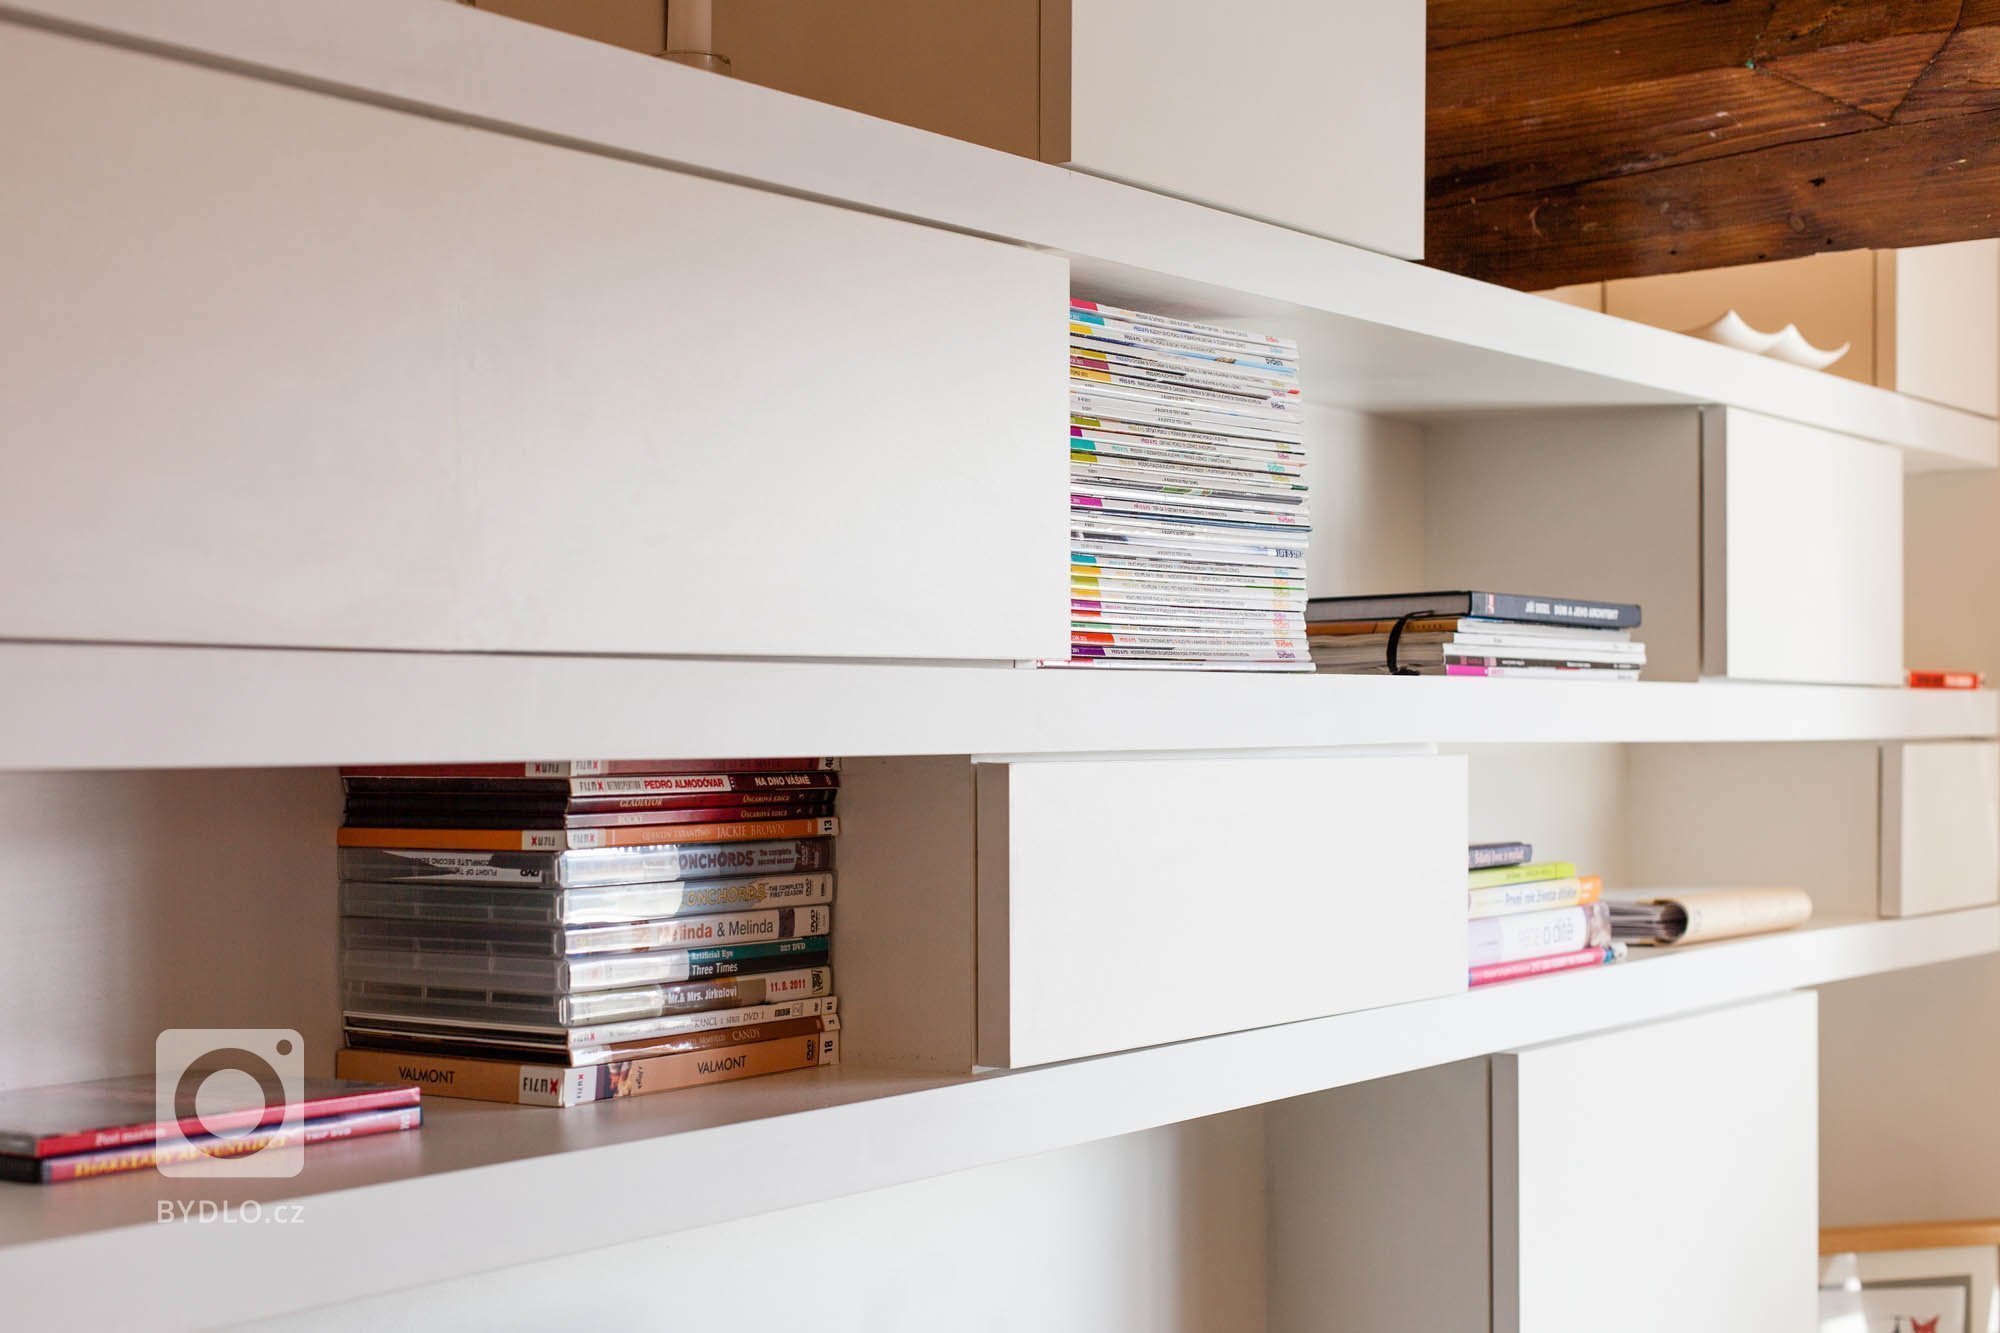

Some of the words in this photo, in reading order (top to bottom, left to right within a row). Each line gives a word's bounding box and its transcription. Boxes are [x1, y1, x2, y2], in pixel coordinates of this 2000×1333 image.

[644, 780, 672, 790] PEDRO
[674, 776, 725, 789] ALMODÓVAR
[754, 777, 767, 787] NA
[768, 776, 785, 786] DNO
[716, 825, 747, 839] JACKIE
[750, 823, 786, 835] BROWN
[824, 820, 833, 831] 13
[716, 921, 725, 937] &
[728, 918, 774, 936] Melinda
[691, 963, 714, 976] Three
[715, 961, 739, 974] Times
[789, 978, 806, 991] 2011
[731, 1027, 761, 1042] CANDY
[824, 1039, 834, 1053] 18
[697, 1055, 747, 1075] VALMONT
[398, 1066, 456, 1085] VALMONT
